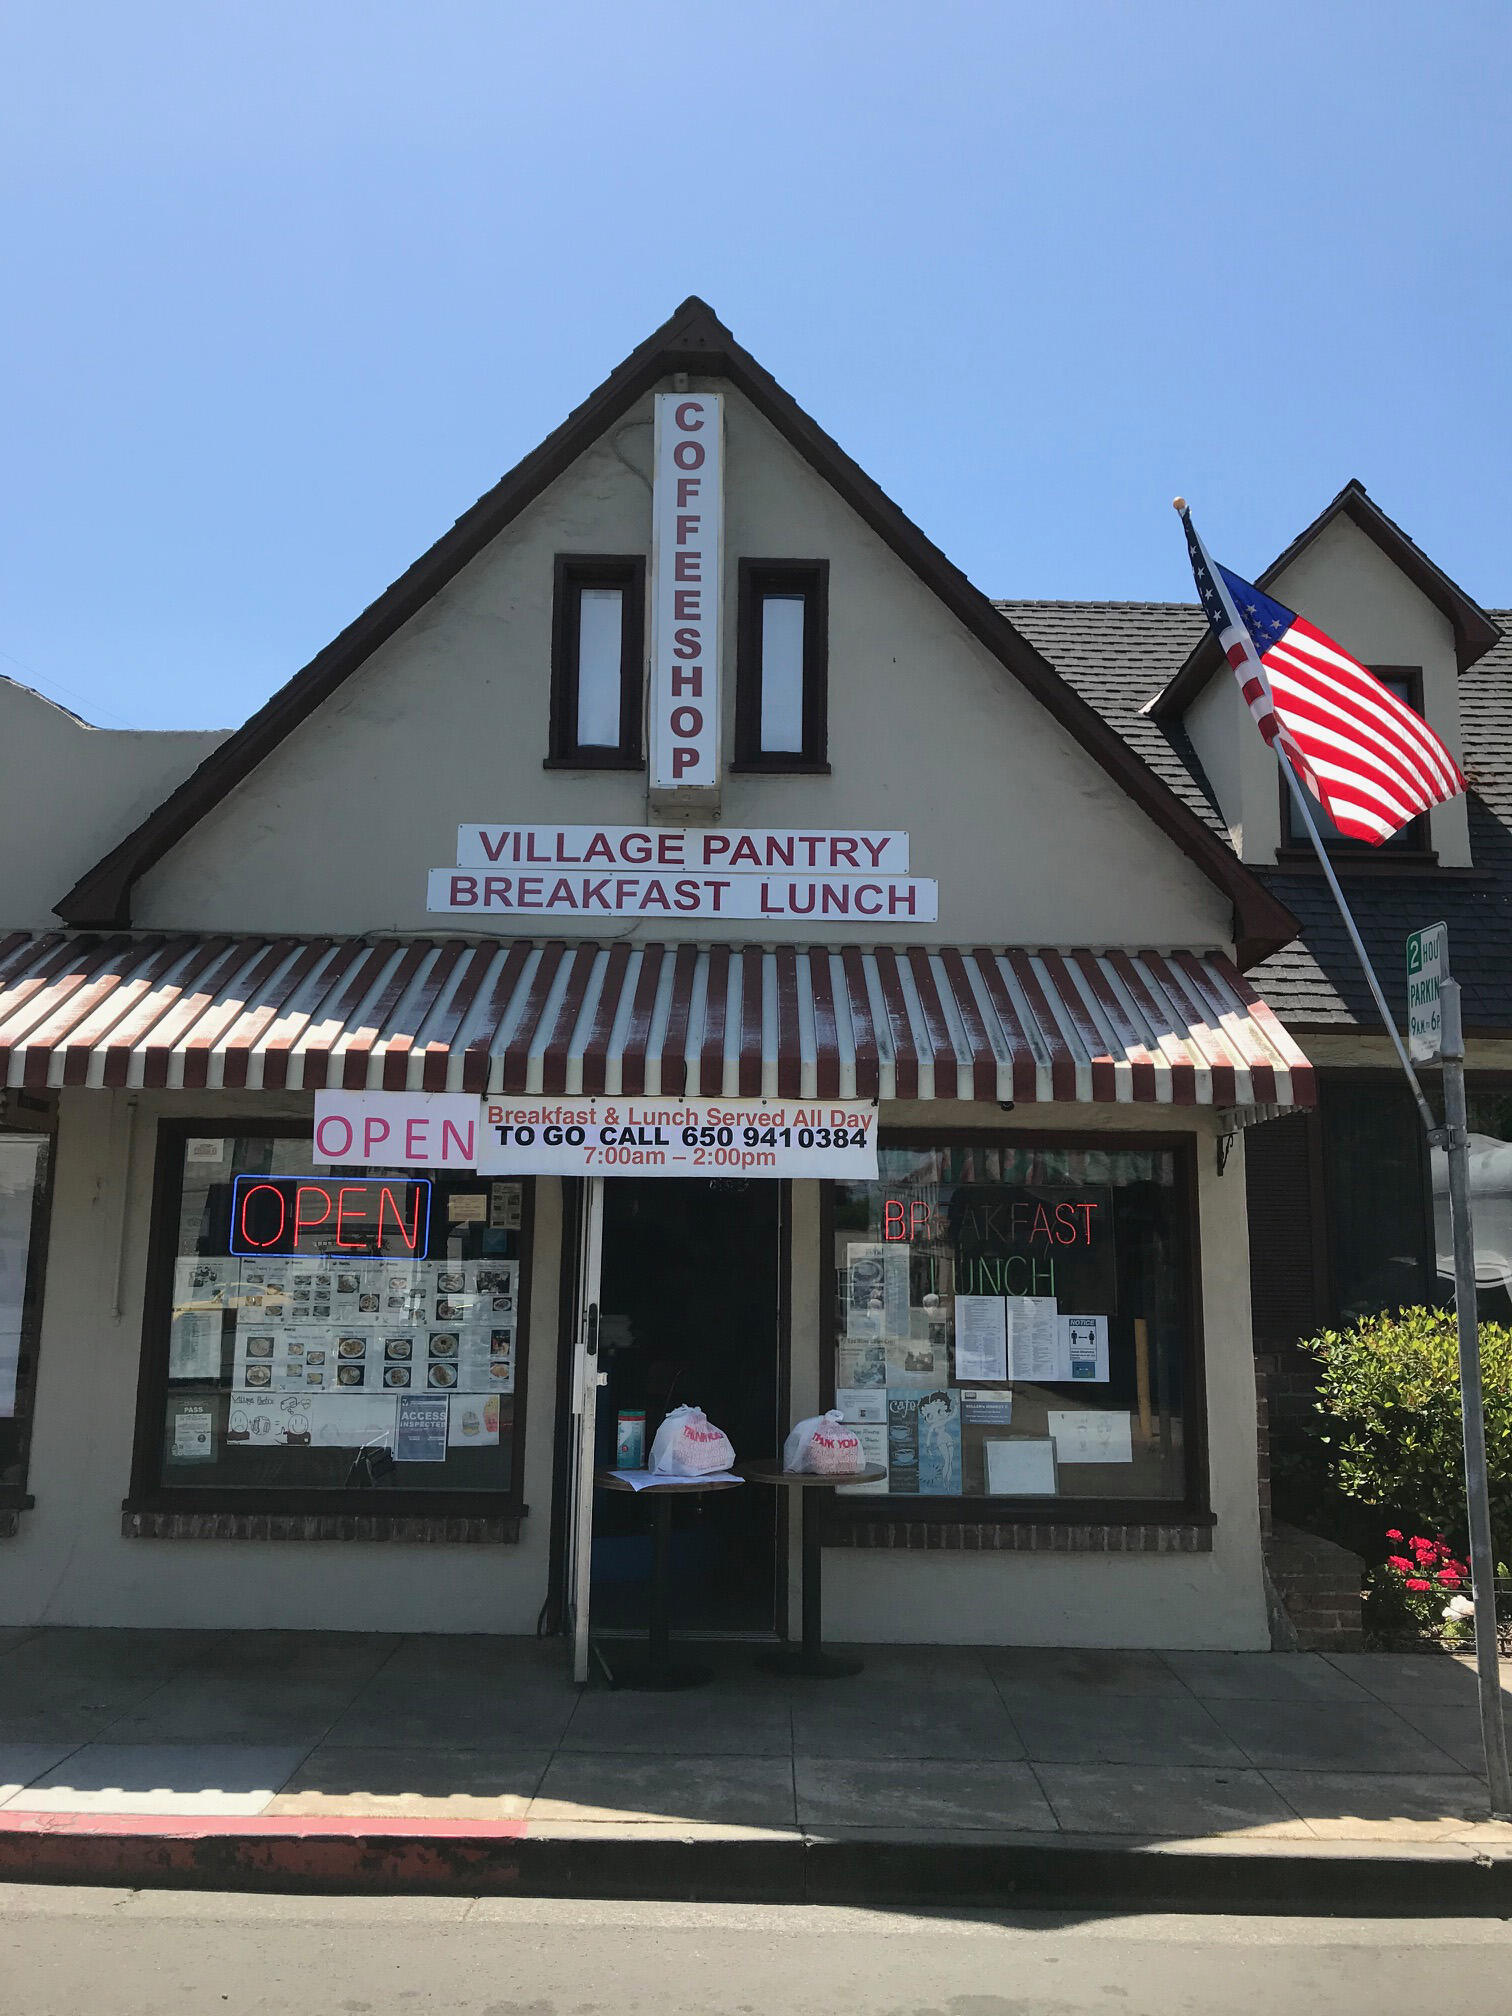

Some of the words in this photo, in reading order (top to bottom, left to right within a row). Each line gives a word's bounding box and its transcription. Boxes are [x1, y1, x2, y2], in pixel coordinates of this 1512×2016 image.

[478, 831, 686, 865] VILLAGE
[702, 833, 892, 869] PANTRY
[449, 876, 731, 911] BREAKFAST
[760, 882, 917, 916] LUNCH
[1410, 941, 1419, 969] 2
[1423, 939, 1440, 963] HOU
[1410, 975, 1440, 1009] PARKIN
[488, 1105, 597, 1125] Breakfast
[604, 1107, 619, 1125] &
[628, 1107, 699, 1126] Lunch
[706, 1108, 785, 1128] Served
[793, 1109, 822, 1127] All
[830, 1109, 872, 1132] Day
[316, 1115, 474, 1161] OPEN
[495, 1125, 535, 1146] TO
[543, 1126, 586, 1146] GO
[600, 1126, 669, 1146] CALL
[681, 1126, 733, 1147] 650
[584, 1146, 665, 1165] 7:00am
[693, 1147, 776, 1170] 2:00pm
[241, 1185, 420, 1249] OPEN
[184, 1406, 204, 1414] PASS
[401, 1411, 446, 1421] ACCESS
